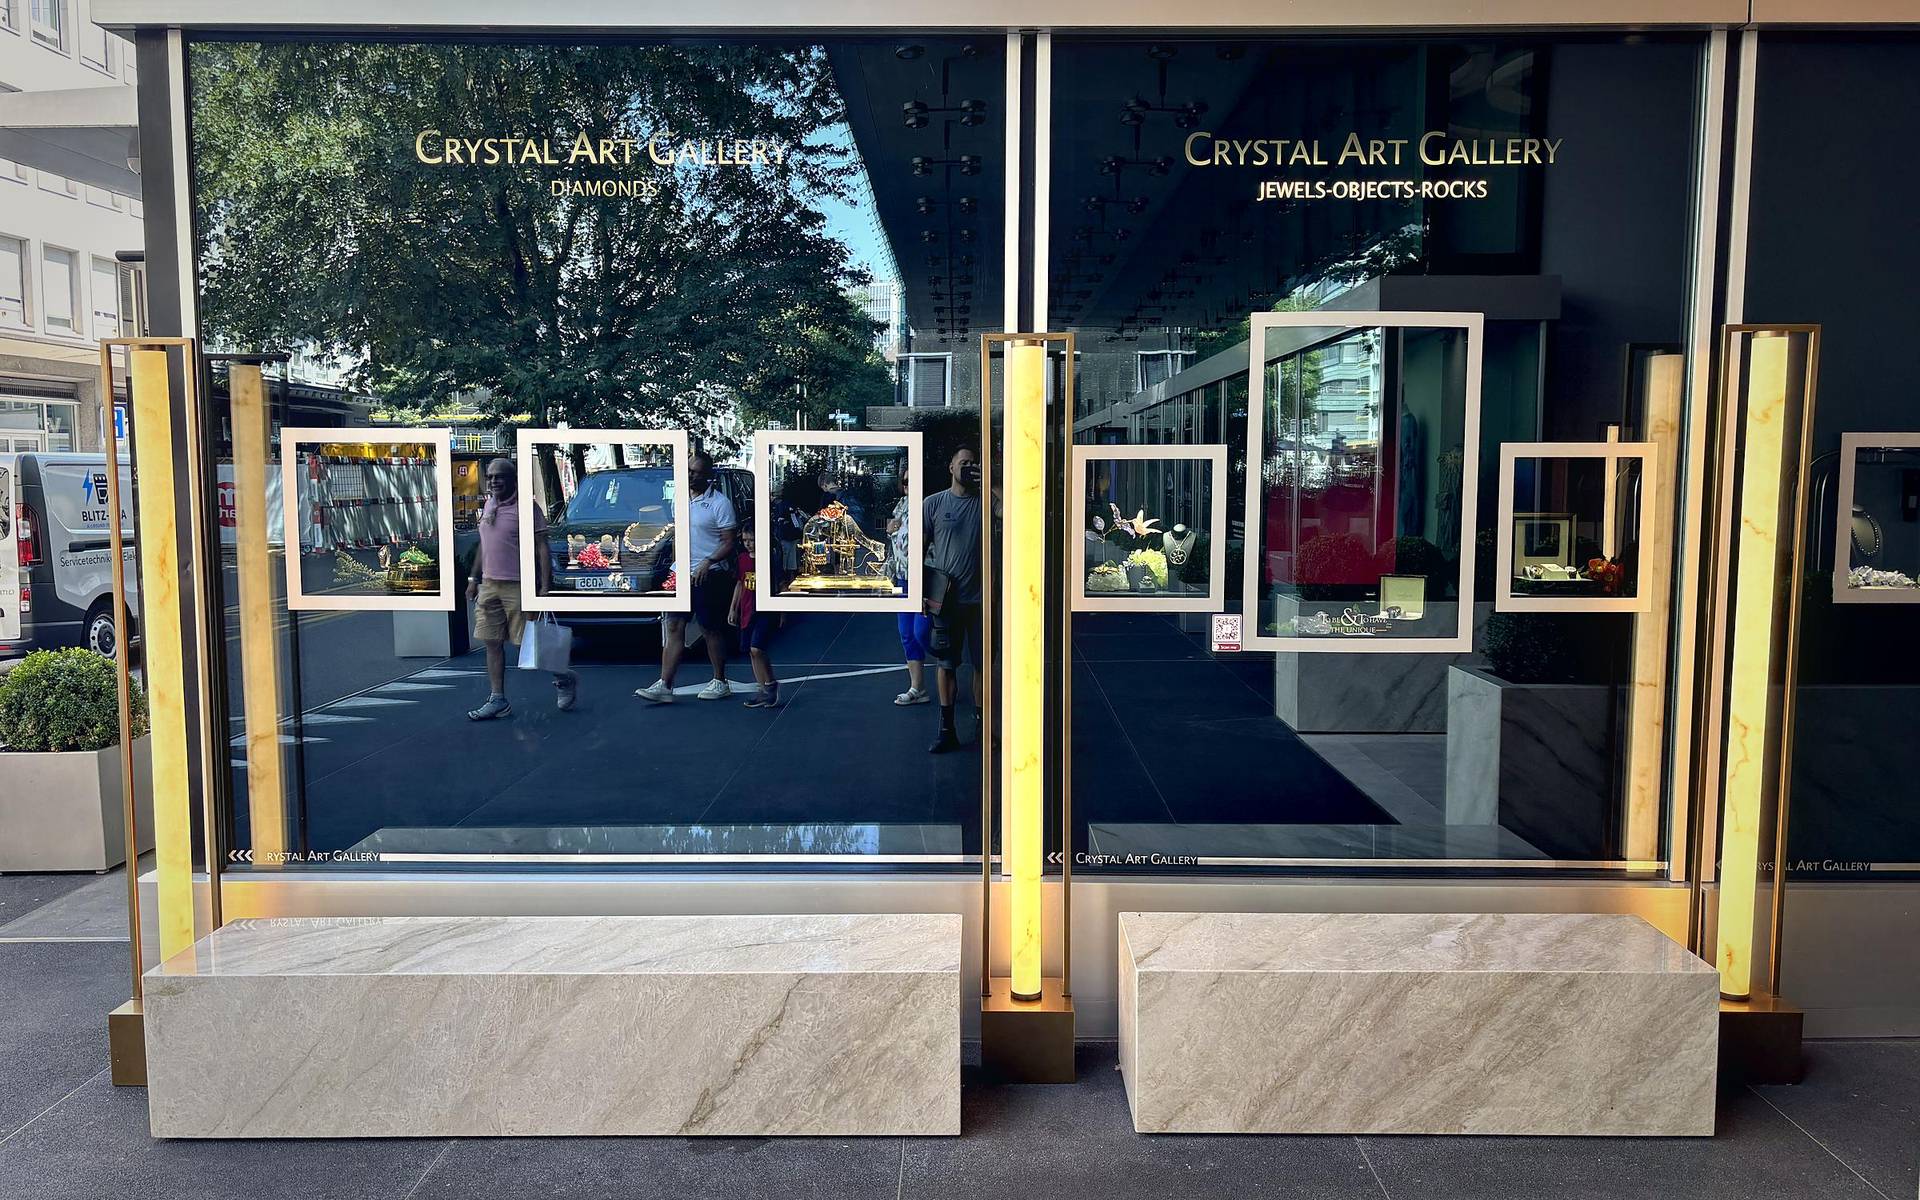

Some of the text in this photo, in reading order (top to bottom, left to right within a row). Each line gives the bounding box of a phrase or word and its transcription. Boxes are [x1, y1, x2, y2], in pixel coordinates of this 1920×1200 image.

[1184, 131, 1563, 166] CRYSTAL ART GALLERY
[551, 180, 657, 198] DIAMONDS
[1256, 180, 1488, 202] JEWELS-OBJECTS-ROCKS
[82, 509, 127, 522] BLITZ-A
